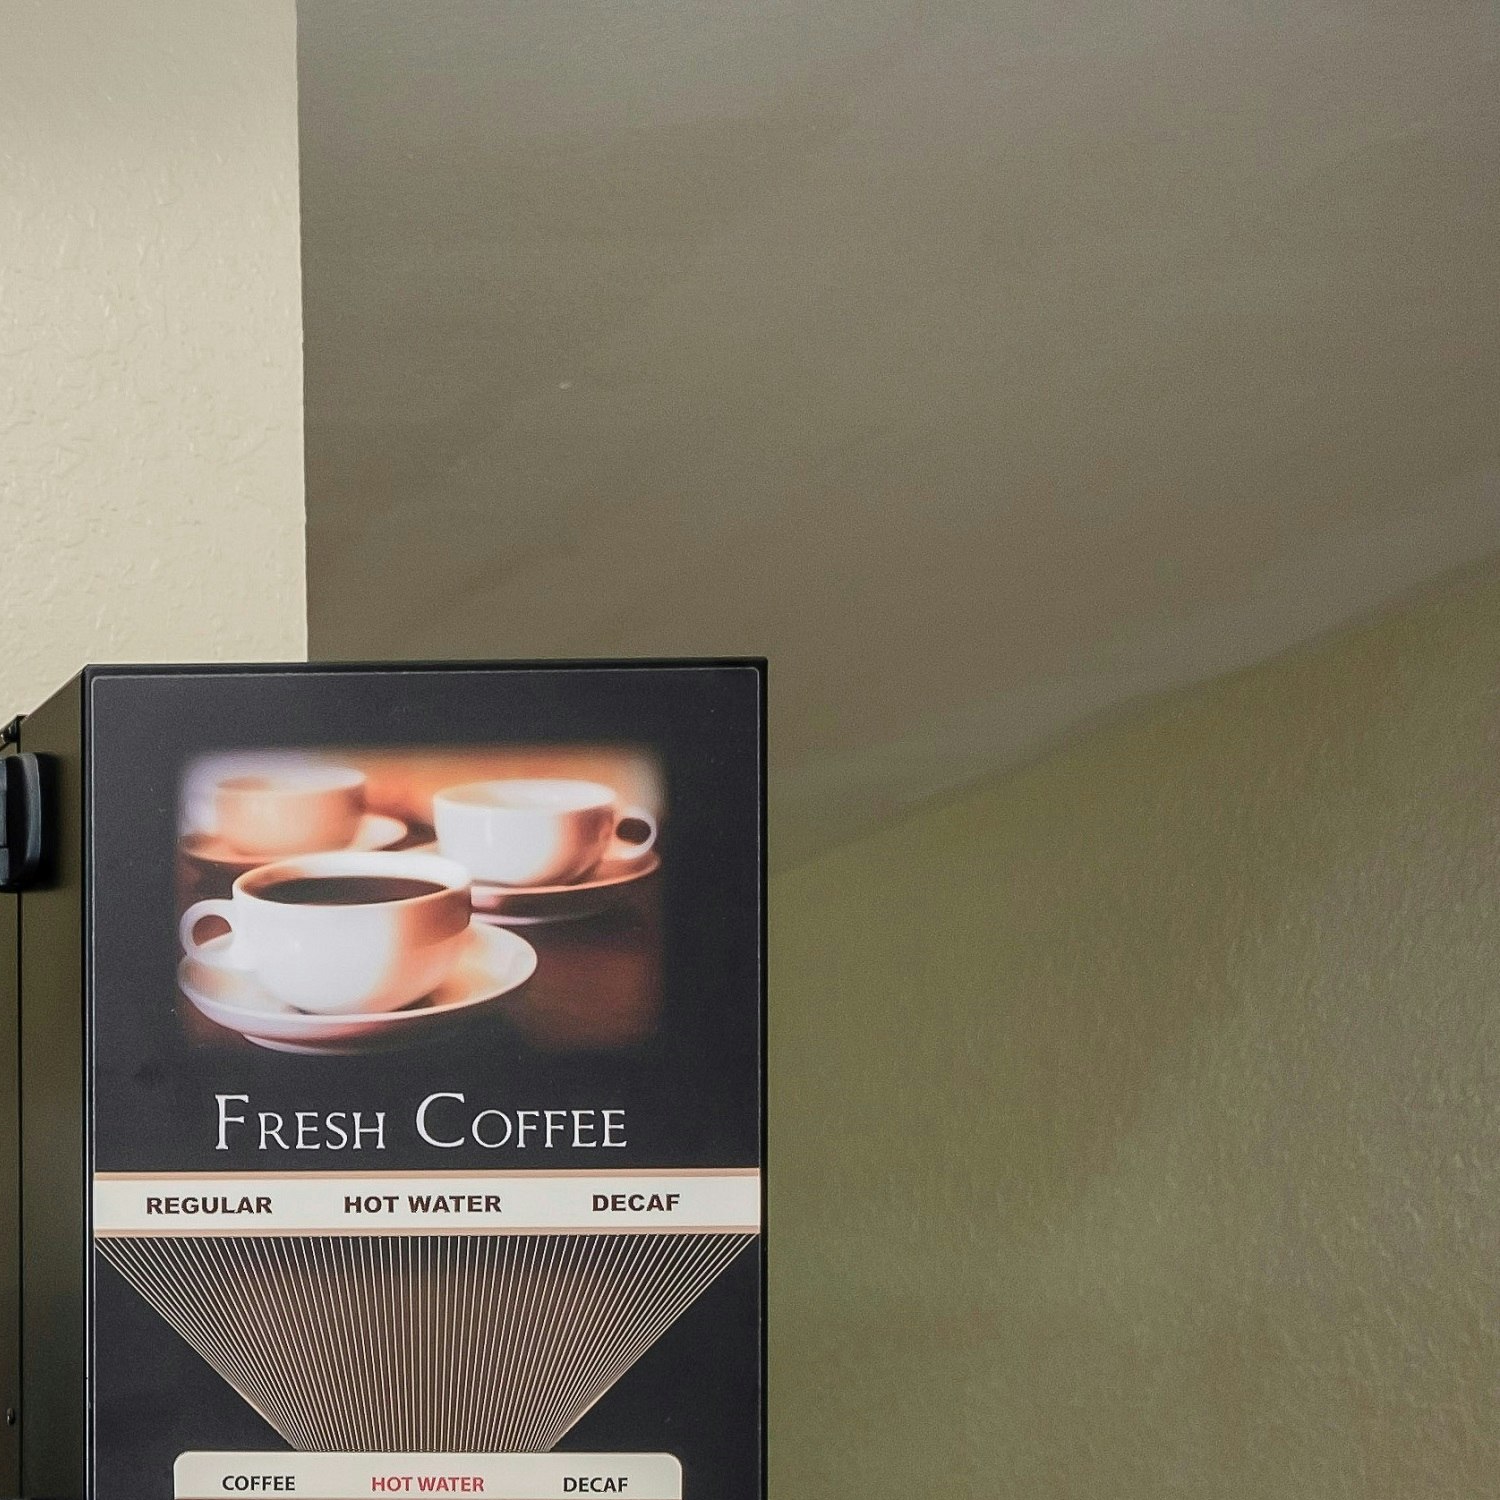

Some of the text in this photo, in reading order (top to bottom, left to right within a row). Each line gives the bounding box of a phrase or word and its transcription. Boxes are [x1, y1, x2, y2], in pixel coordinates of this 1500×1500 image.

[214, 1092, 627, 1150] FRESH COFFEE
[146, 1196, 273, 1215] REGULAR
[344, 1194, 502, 1214] HOT WATER
[591, 1193, 681, 1213] DECAF
[222, 1475, 296, 1491] COFFEE
[371, 1476, 485, 1493] HOT WATER
[563, 1477, 628, 1493] DECAF
